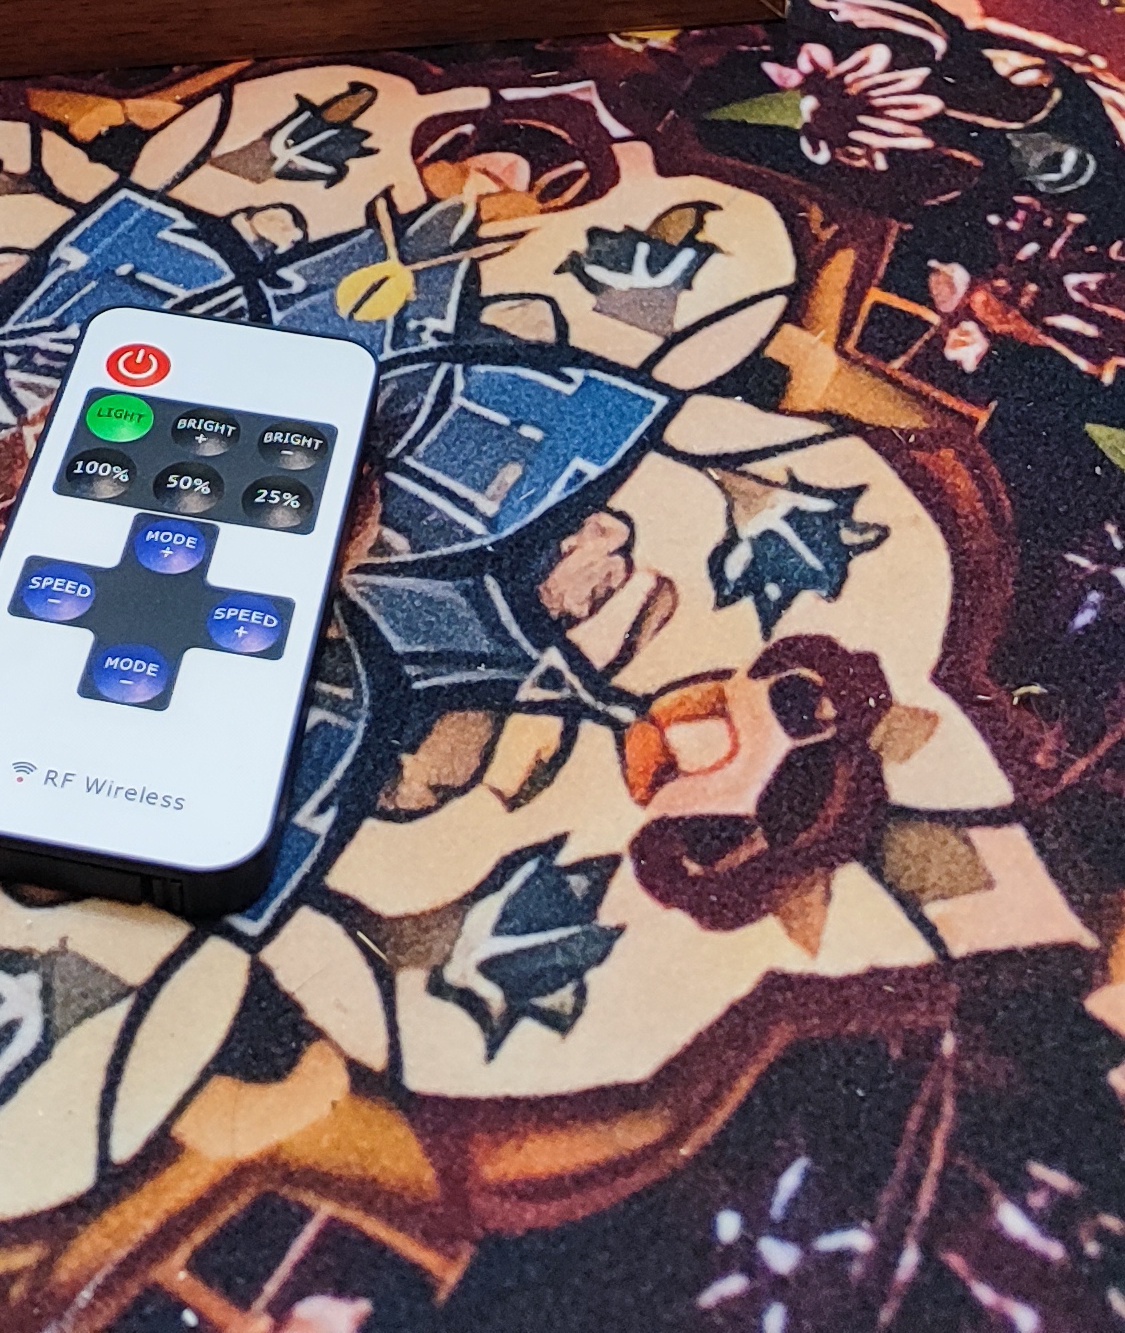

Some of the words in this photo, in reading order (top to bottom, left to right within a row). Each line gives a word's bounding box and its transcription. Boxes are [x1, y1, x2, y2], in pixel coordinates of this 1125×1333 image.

[96, 406, 147, 424] LIGHT
[176, 418, 238, 438] BRIGHT
[262, 431, 324, 451] BRIGHT
[72, 460, 130, 483] 100%
[166, 474, 211, 495] 50%
[254, 489, 301, 509] 25%
[145, 530, 198, 550] MODE
[28, 575, 92, 598] SPEED
[212, 607, 279, 628] SPEED
[103, 656, 160, 678] MODE
[43, 769, 77, 789] RF
[85, 775, 186, 811] Wireless
